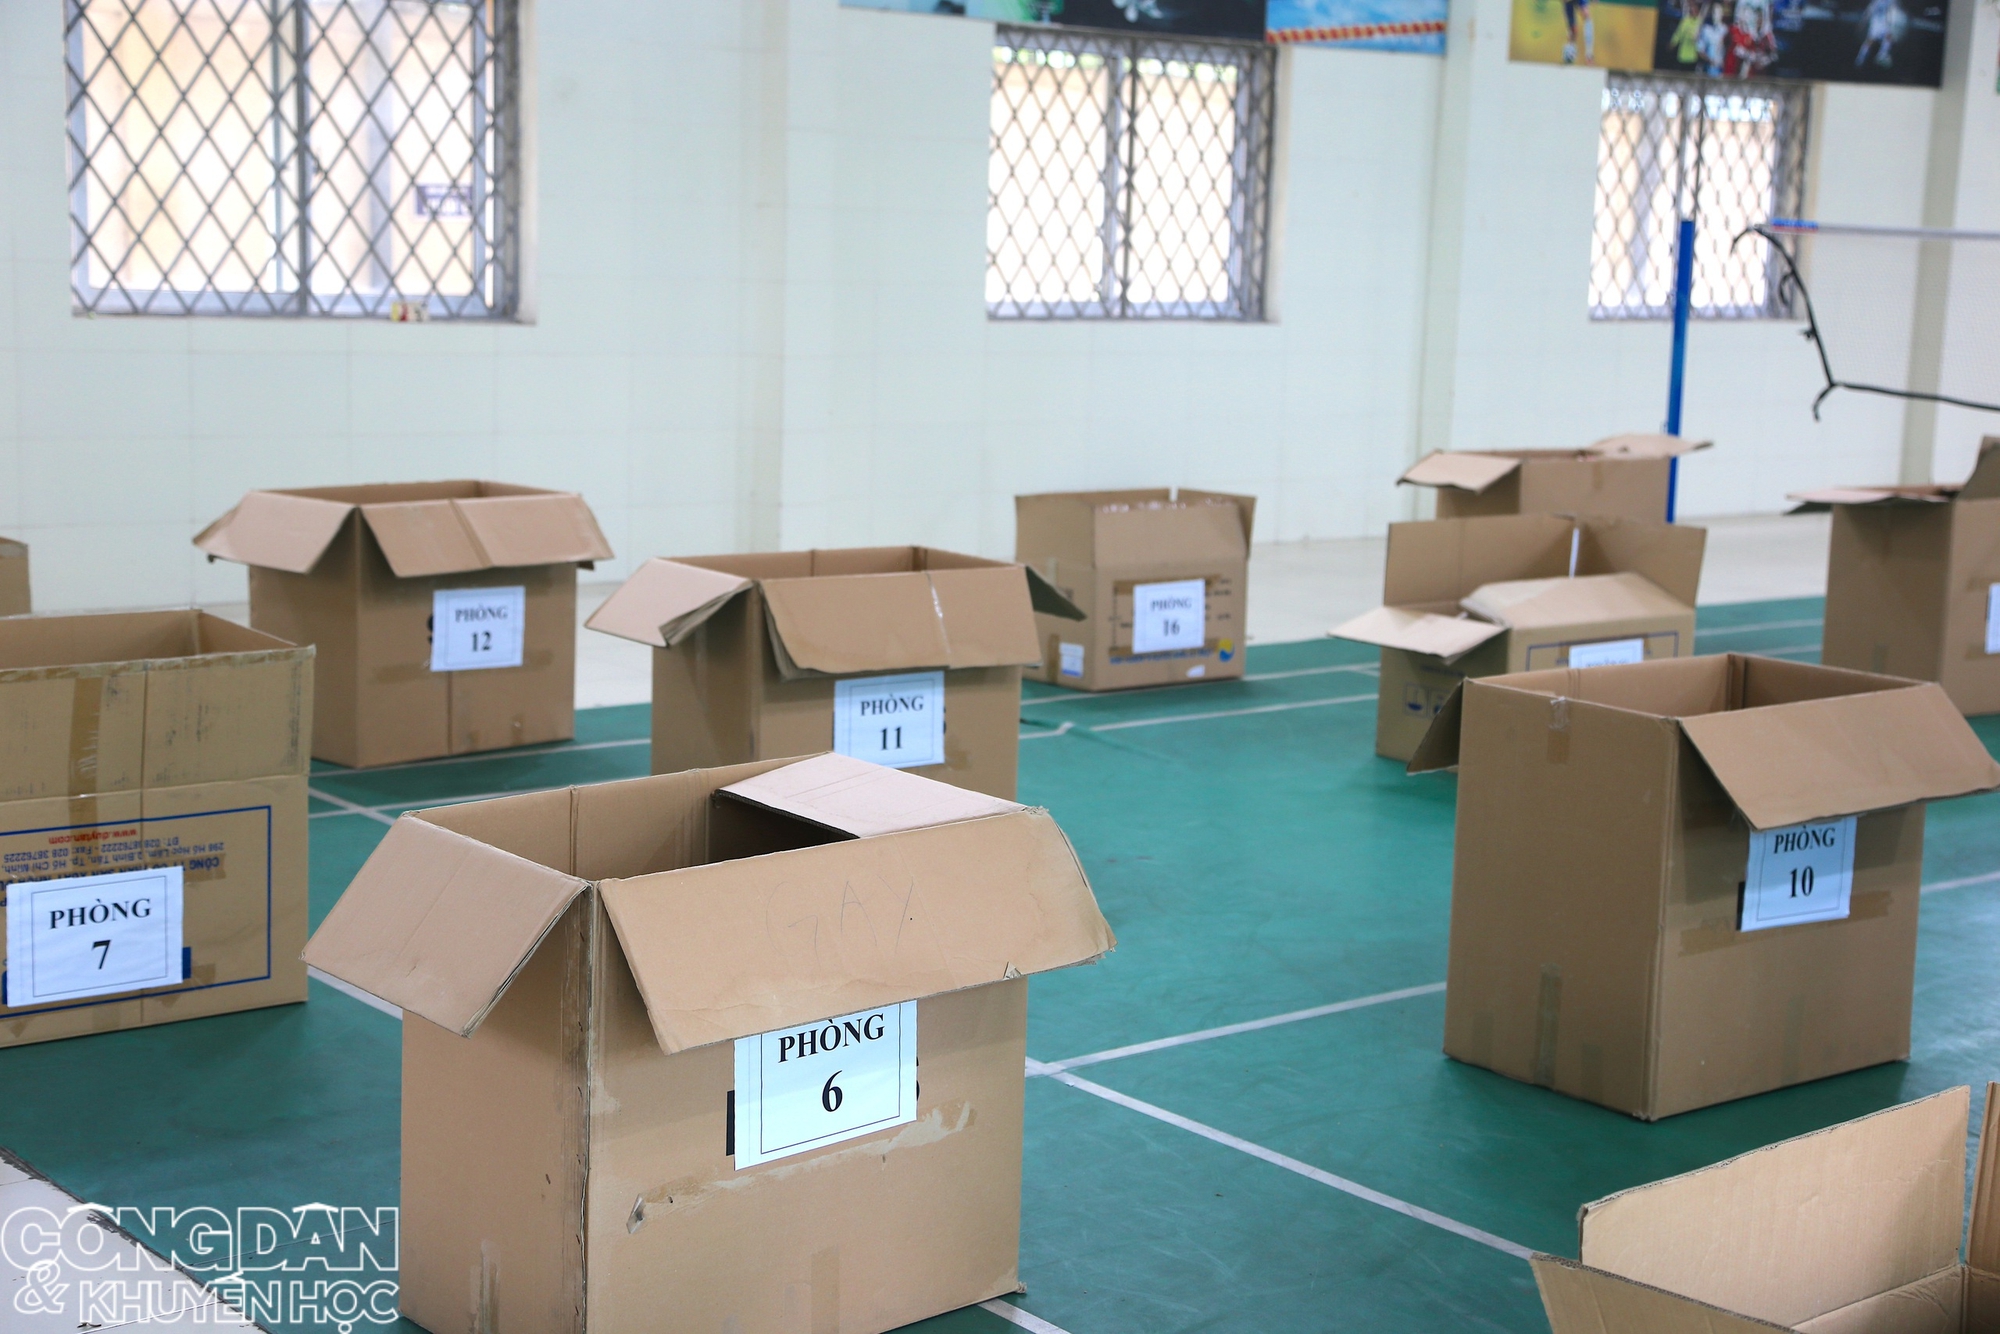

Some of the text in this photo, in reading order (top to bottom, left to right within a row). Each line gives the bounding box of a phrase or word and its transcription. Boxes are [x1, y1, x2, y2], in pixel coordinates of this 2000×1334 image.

[454, 604, 508, 623] PHÒNG
[1150, 596, 1192, 611] PHÒNG
[471, 631, 492, 653] 12
[1163, 620, 1180, 637] 16
[859, 694, 925, 717] PHÒNG
[880, 726, 903, 751] 11
[1773, 825, 1836, 855] PHÒNG
[1789, 866, 1814, 899] 10
[49, 898, 152, 929] PHÒNG
[92, 939, 111, 970] 7
[778, 1012, 885, 1063] PHÒNG
[821, 1070, 844, 1114] 6
